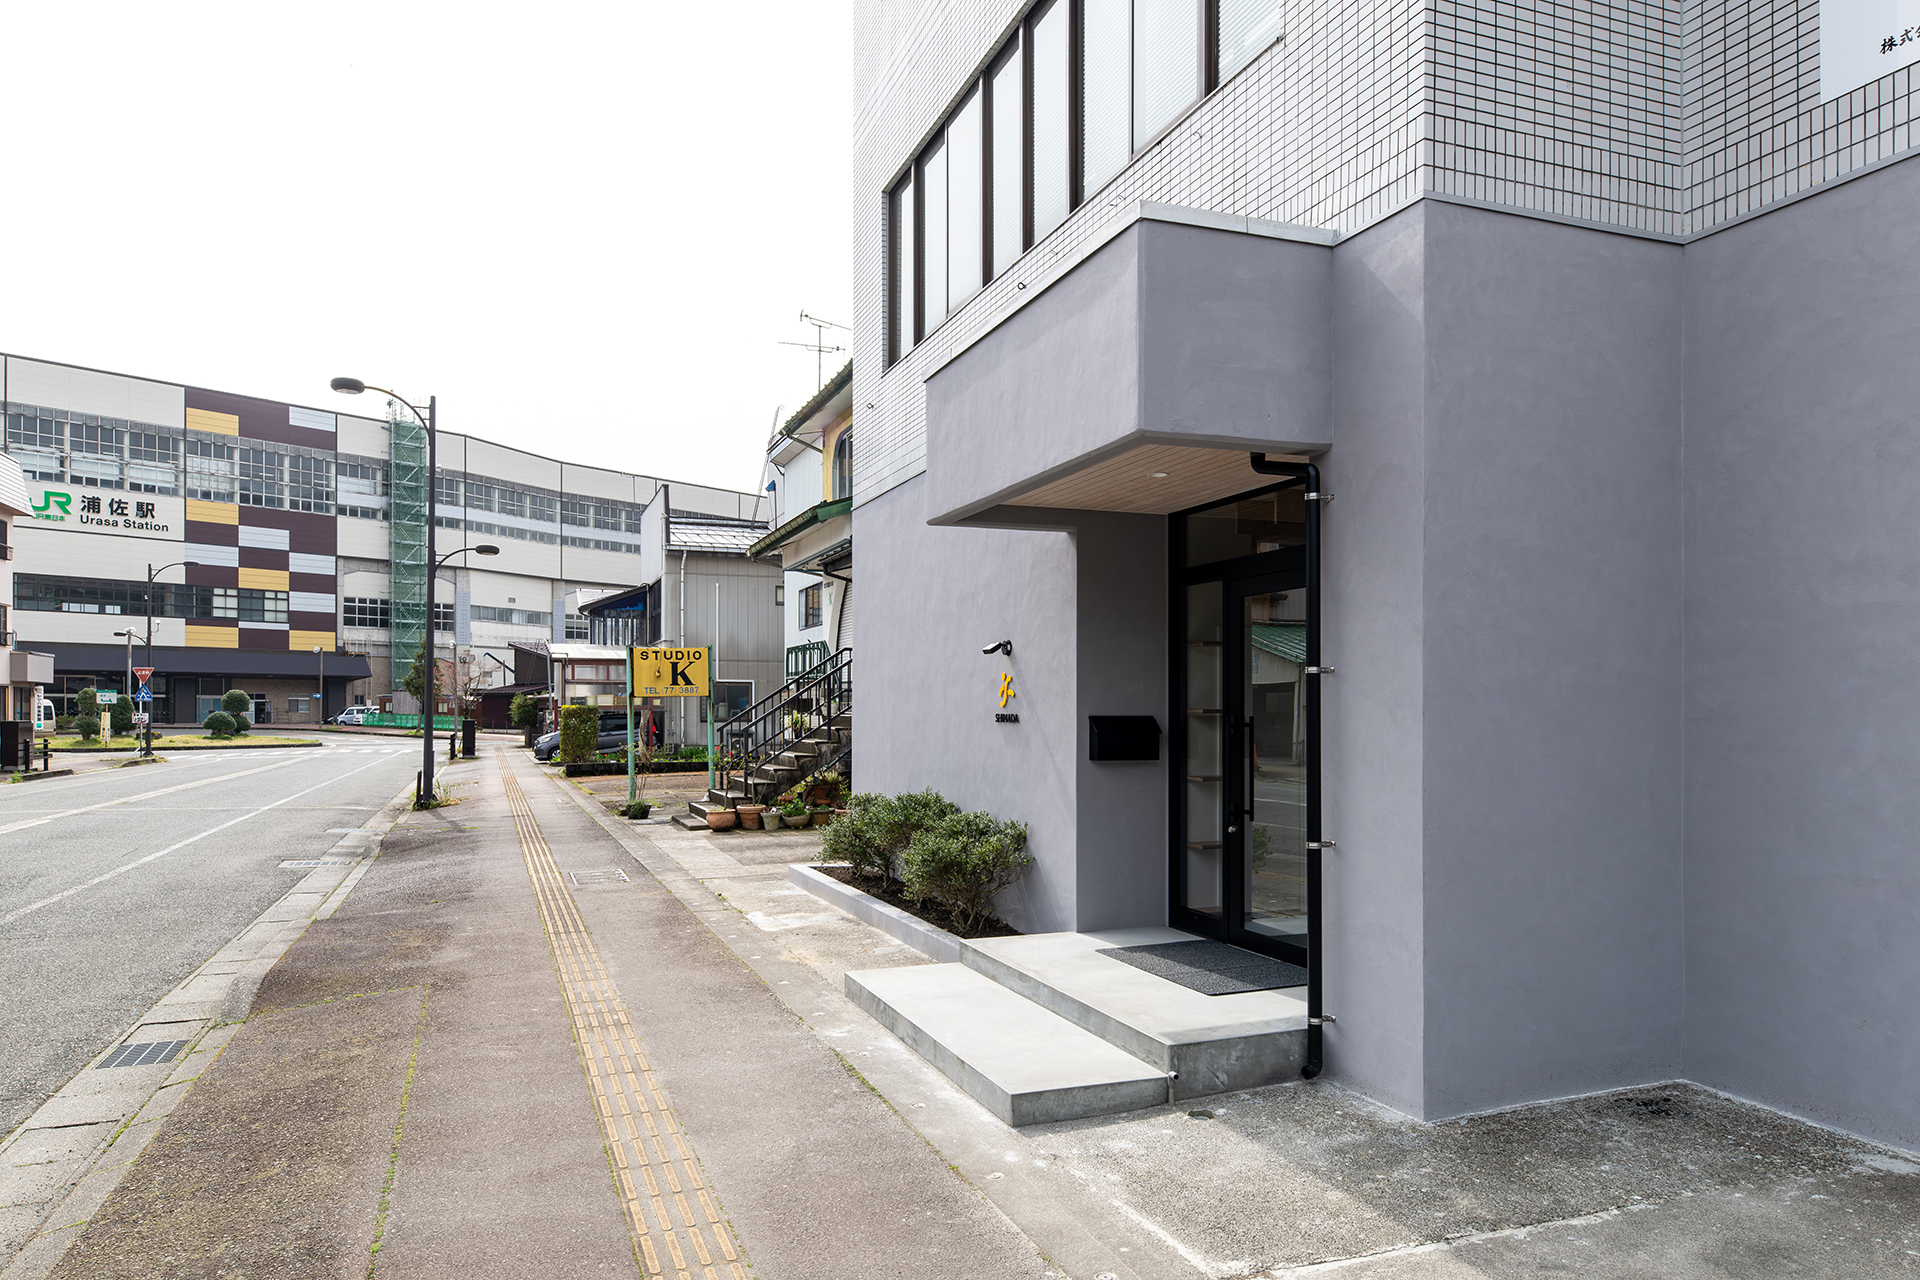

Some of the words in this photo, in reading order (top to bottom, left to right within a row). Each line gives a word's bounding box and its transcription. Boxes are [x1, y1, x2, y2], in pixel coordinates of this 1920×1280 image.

[29, 490, 72, 515] JR
[80, 494, 156, 519] 浦佐駅
[80, 514, 119, 527] Urasa
[123, 518, 169, 532] Station
[640, 650, 702, 661] STUDIO
[669, 661, 696, 686] K
[644, 687, 660, 695] TEL
[678, 686, 700, 694] 3887
